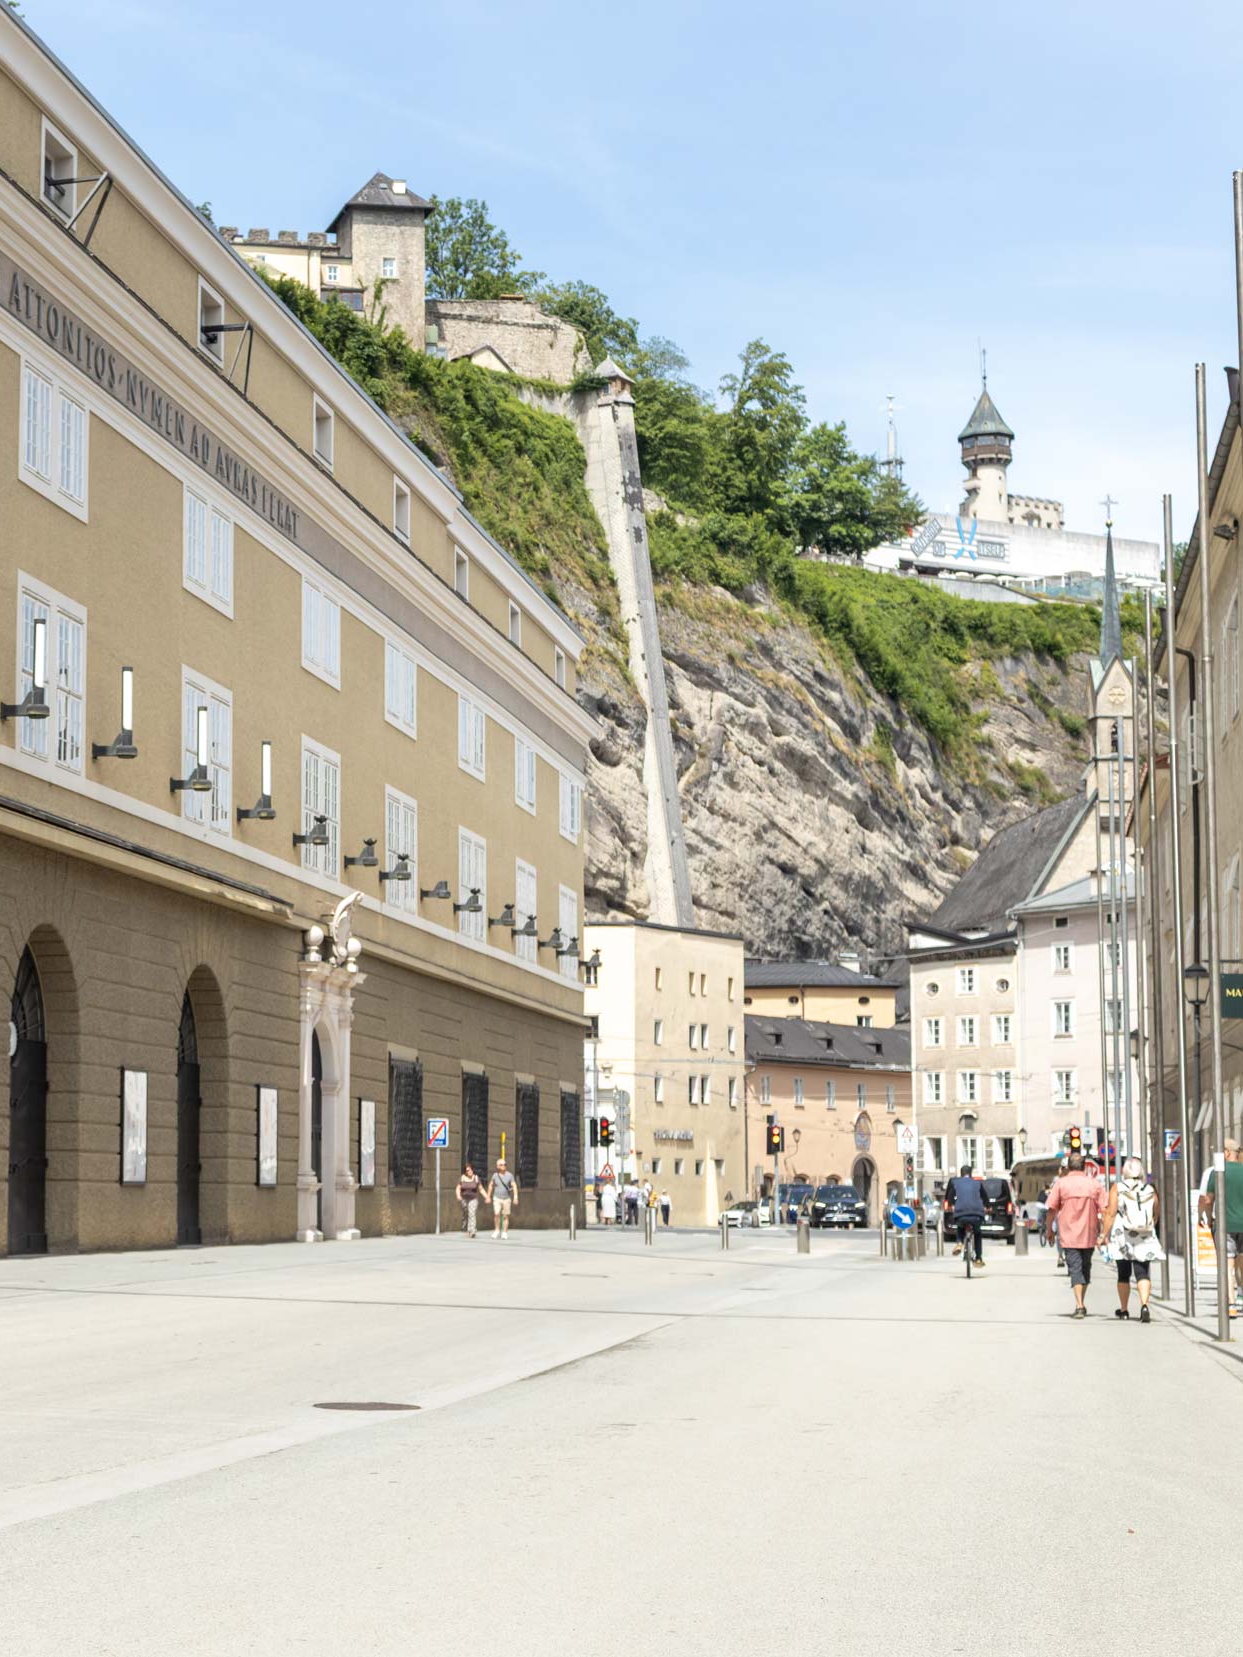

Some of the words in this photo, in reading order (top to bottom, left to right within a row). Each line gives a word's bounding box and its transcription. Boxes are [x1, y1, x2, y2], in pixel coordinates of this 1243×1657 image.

[126, 368, 185, 447] NVMEN
[214, 446, 258, 506] AVRAS
[1226, 987, 1243, 998] MA
